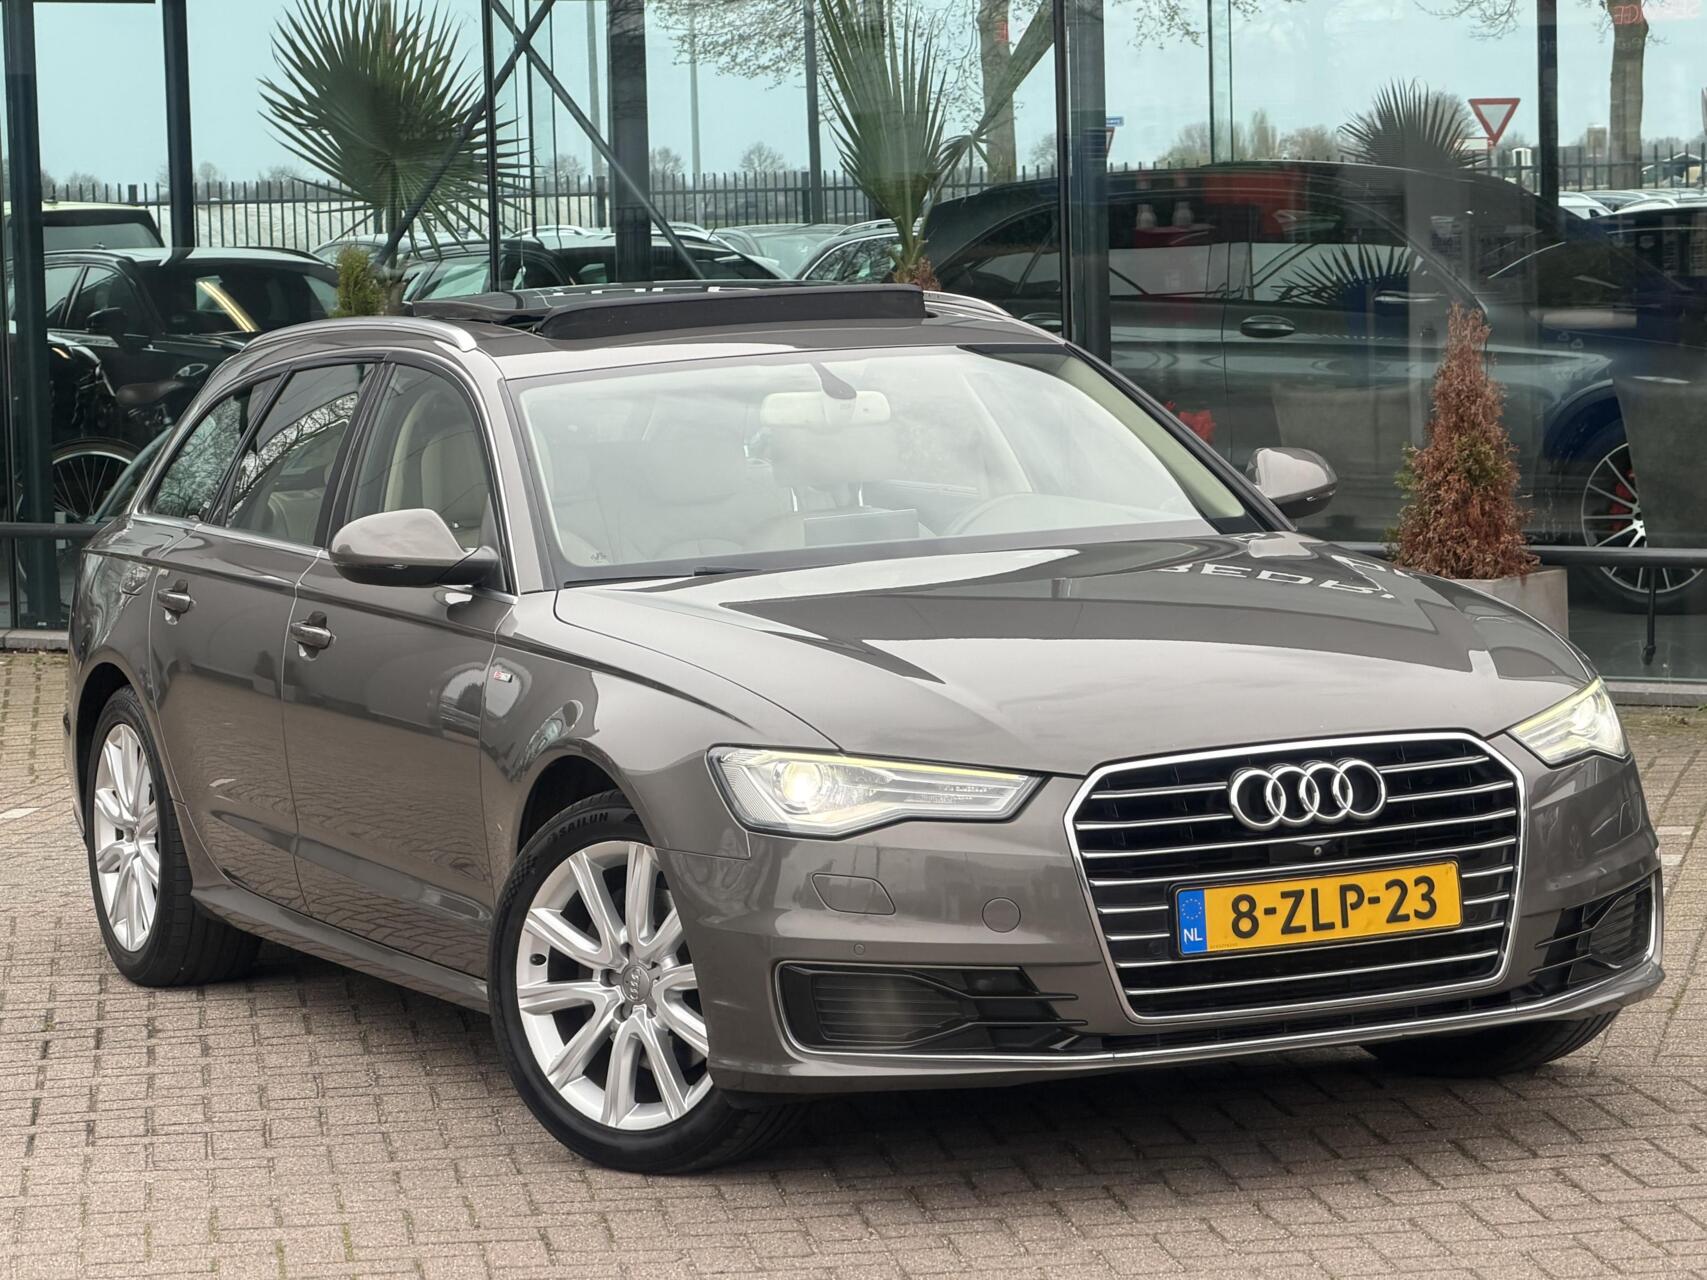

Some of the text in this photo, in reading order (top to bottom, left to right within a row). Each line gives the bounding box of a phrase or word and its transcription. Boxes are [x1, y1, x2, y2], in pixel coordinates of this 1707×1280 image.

[559, 812, 609, 837] SAILUN
[1231, 875, 1437, 939] 8-ZLP-23
[1183, 928, 1203, 944] NL
